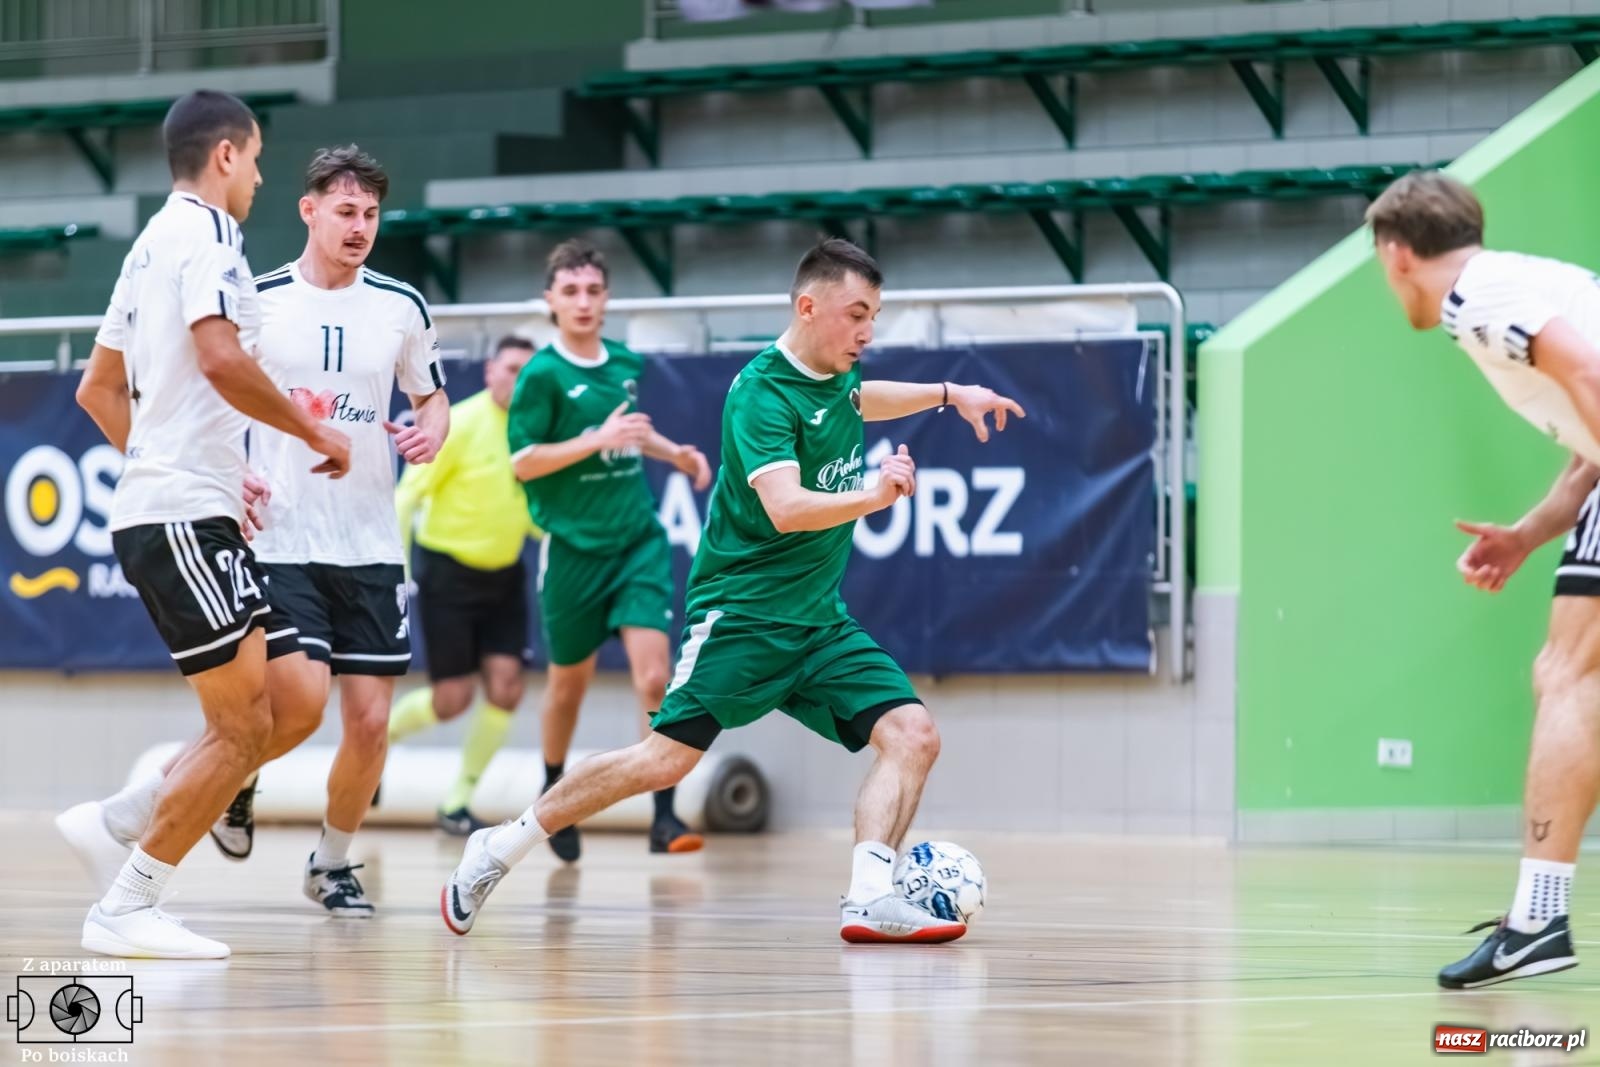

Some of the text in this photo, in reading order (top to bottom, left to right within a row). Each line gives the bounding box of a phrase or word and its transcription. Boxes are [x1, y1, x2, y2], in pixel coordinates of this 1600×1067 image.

[320, 325, 343, 372] 11
[4, 444, 126, 557] OS
[215, 549, 262, 612] 24
